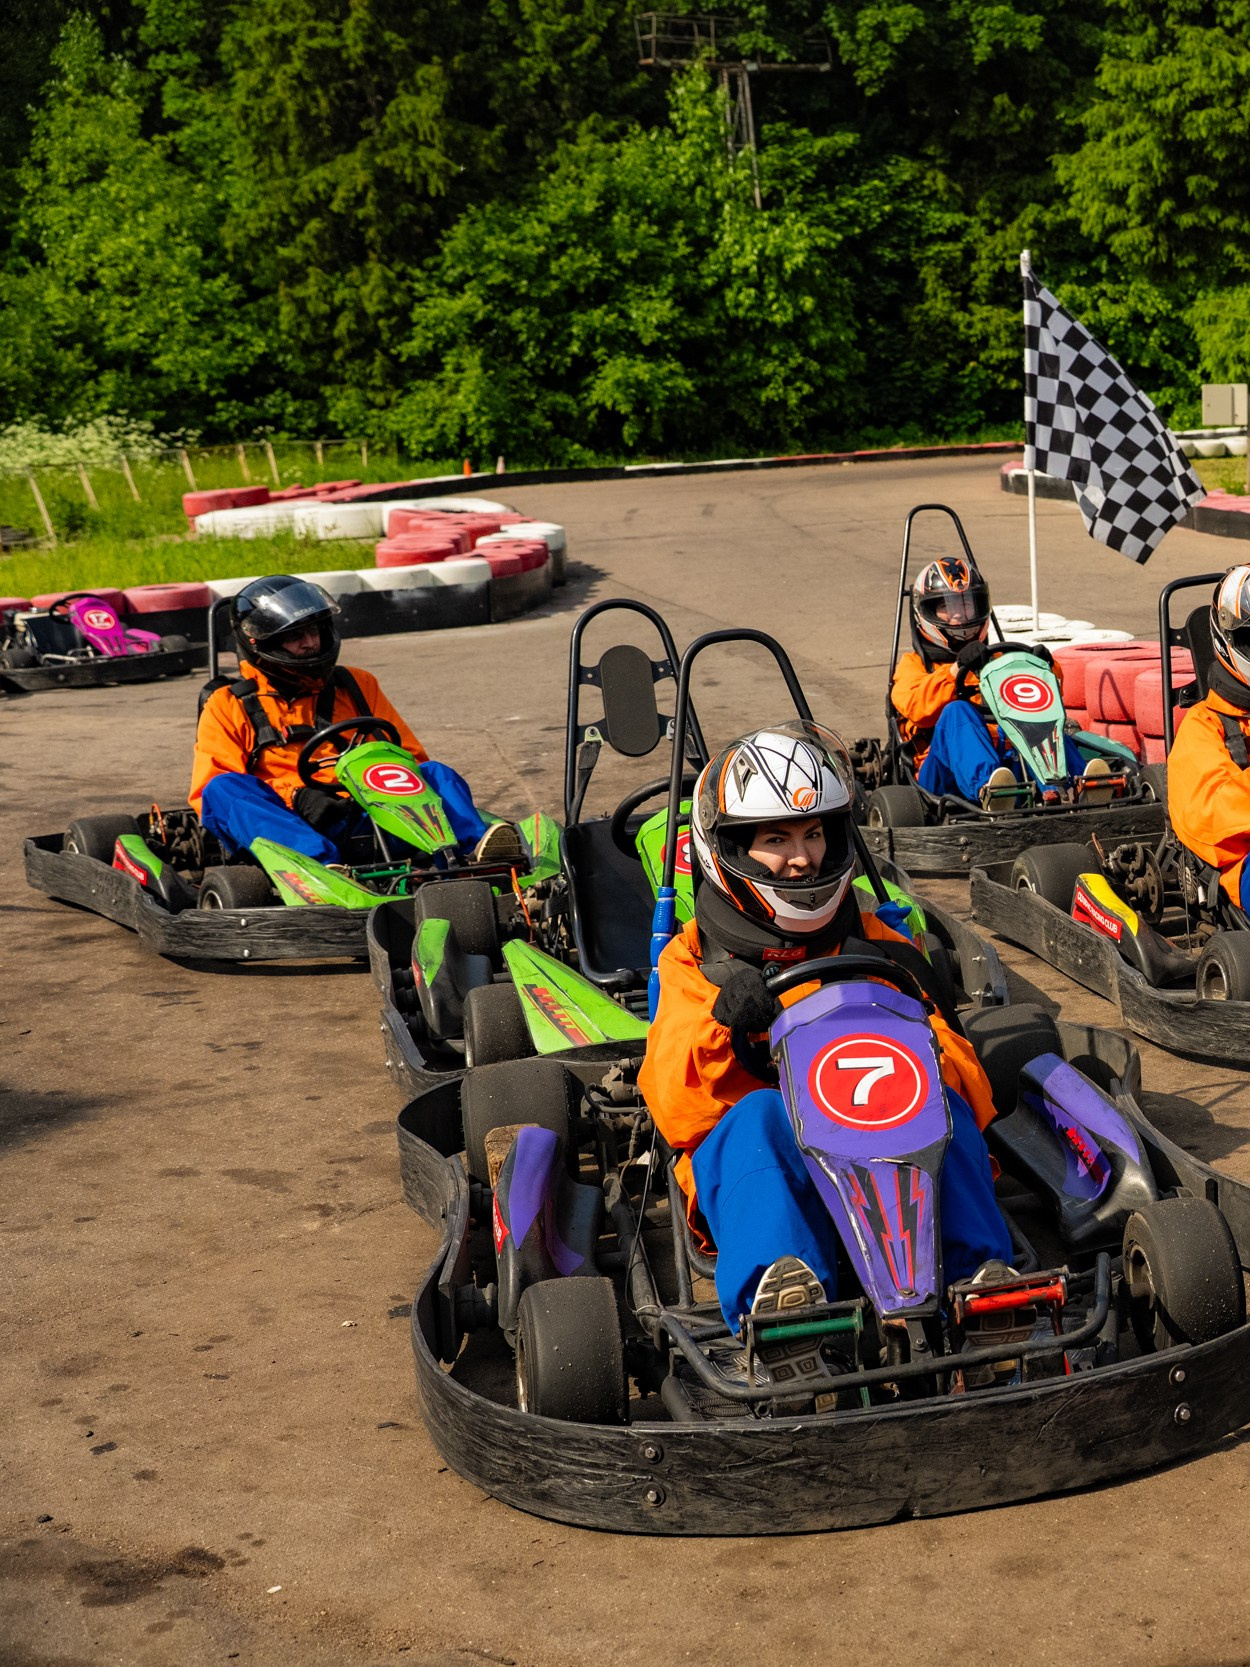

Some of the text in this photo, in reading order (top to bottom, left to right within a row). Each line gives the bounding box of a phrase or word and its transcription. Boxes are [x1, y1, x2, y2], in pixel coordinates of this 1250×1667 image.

[1013, 683, 1042, 703] 9
[377, 769, 414, 788] 2
[1104, 918, 1118, 934] CLUB
[836, 1056, 895, 1106] 7
